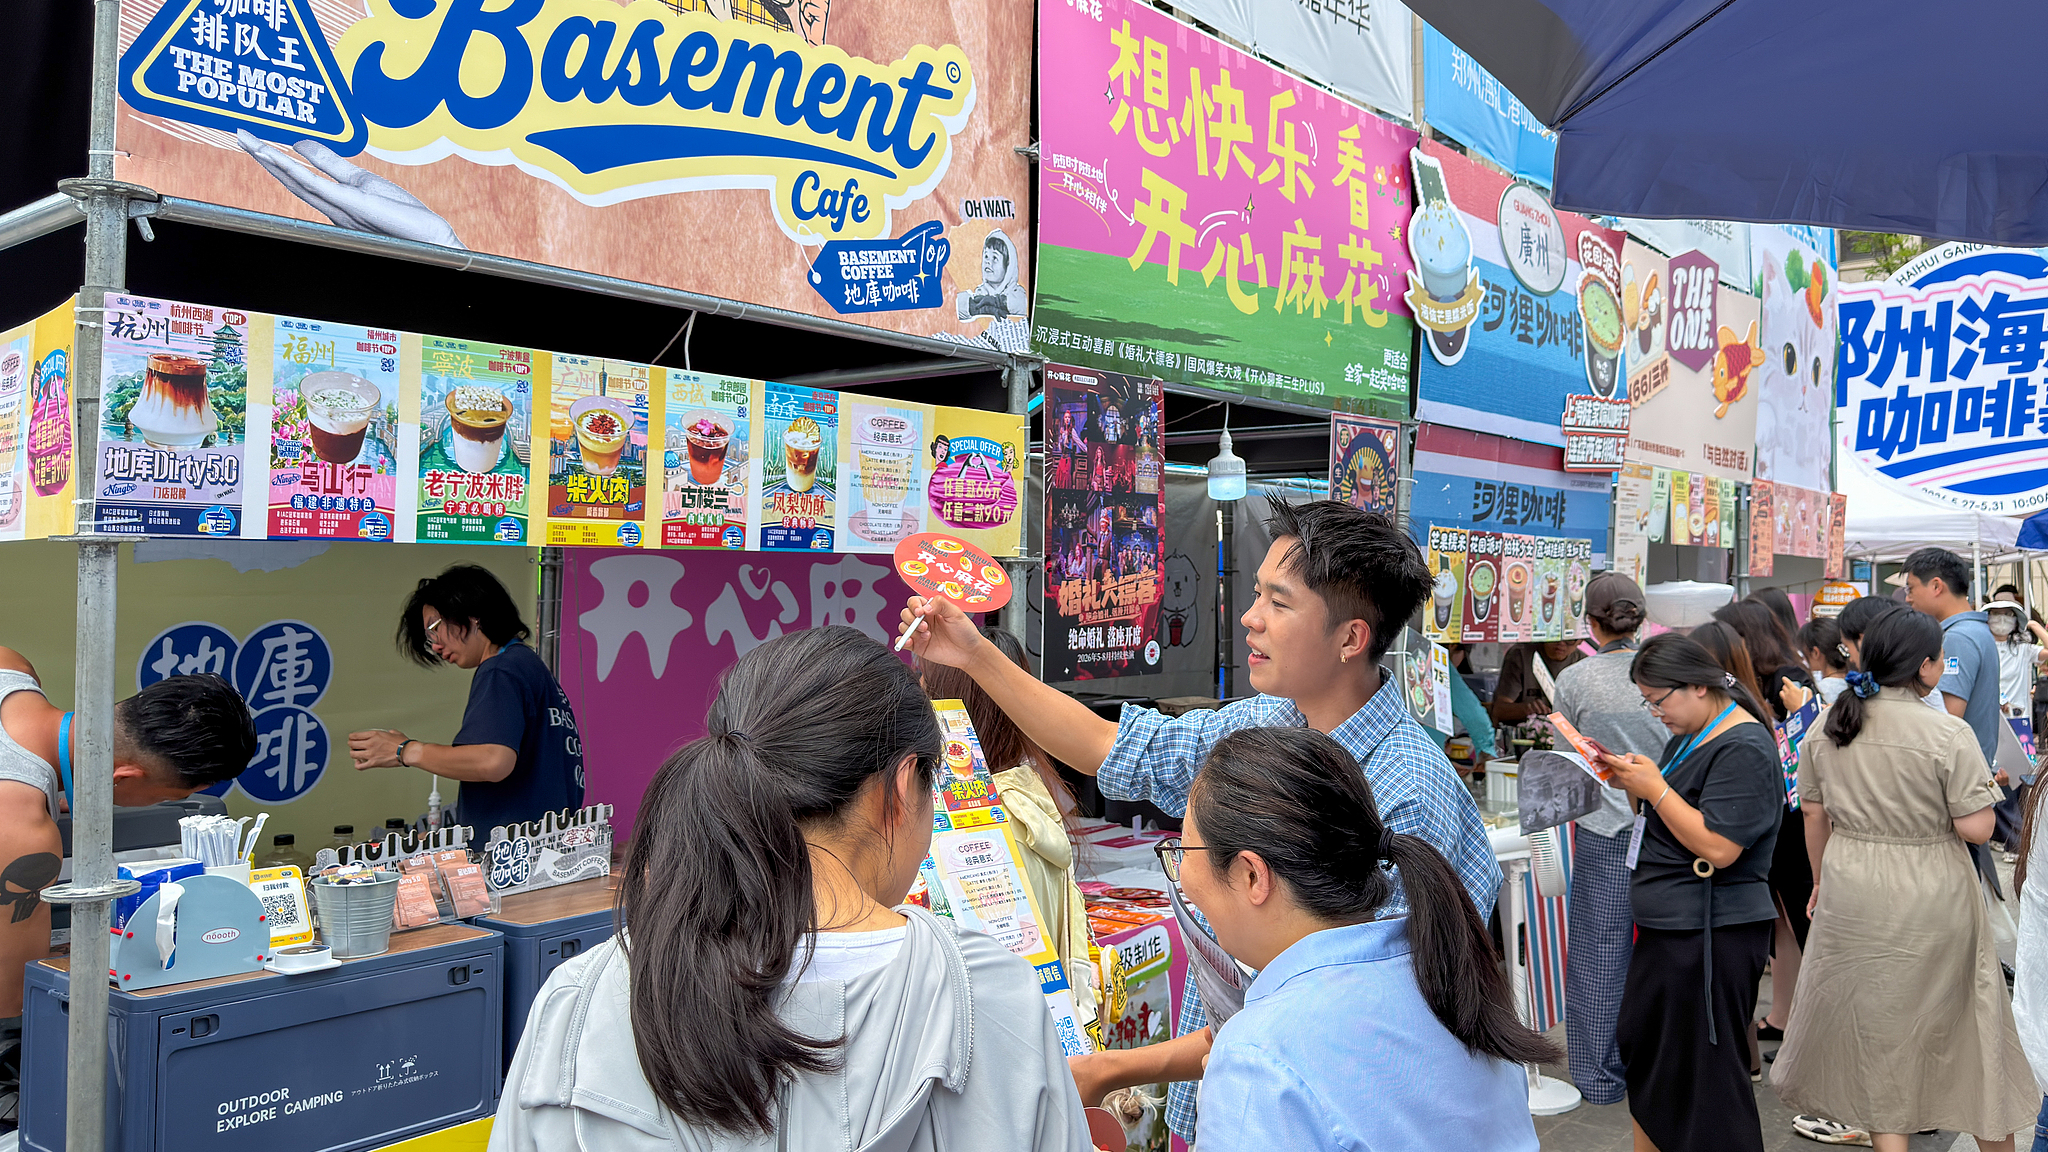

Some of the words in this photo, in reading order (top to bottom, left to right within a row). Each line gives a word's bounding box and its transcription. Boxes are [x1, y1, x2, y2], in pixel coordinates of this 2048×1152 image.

[190, 10, 306, 71] 排队王
[169, 45, 233, 82] THE
[237, 64, 325, 104] MOST
[352, 0, 953, 169] Basement
[177, 70, 317, 125] POPULAR
[1053, 153, 1103, 183] 随时随地
[791, 170, 871, 233] Cafe
[1063, 172, 1107, 213] 开心相伴
[965, 200, 983, 218] OH
[984, 200, 1015, 220] WAIT,
[838, 250, 917, 266] BASEMENT
[902, 225, 947, 278] Top
[1128, 166, 1388, 328] 开心麻花
[1518, 222, 1550, 276] 廣州
[840, 264, 894, 280] COFFEE
[1896, 254, 1940, 286] HAIHUI
[844, 278, 920, 307] 地庫咖啡
[1672, 264, 1717, 312] THE
[170, 303, 214, 322] 杭州西湖
[225, 313, 243, 325] TOP1
[1482, 278, 1583, 361] 河狸咖啡
[108, 312, 170, 345] 杭州
[171, 320, 204, 336] 咖啡节
[1670, 307, 1714, 351] ONE.
[282, 333, 335, 368] 福州
[432, 351, 475, 380] 寧波
[1383, 348, 1409, 371] 更适合
[1343, 362, 1409, 393] 全家一起笑哈哈
[871, 417, 906, 430] COFFEE
[950, 439, 979, 453] SPECIAL
[979, 440, 1001, 458] OFFER
[153, 486, 187, 500] 门店招牌
[424, 470, 524, 501] 老宁波米胖
[680, 485, 729, 510] 古楼兰
[292, 494, 374, 512] 福建非遗特色
[772, 491, 826, 517] 凤梨奶酥
[1473, 480, 1567, 531] 河狸咖啡
[917, 550, 995, 595] 开心麻花
[1067, 626, 1105, 650] 绝命婚礼
[1106, 624, 1142, 648] 落座开席
[496, 838, 529, 860] 地庫
[958, 841, 992, 854] COFFEE
[493, 860, 529, 884] 咖啡
[216, 1106, 278, 1133] EXPLORE
[284, 1090, 344, 1115] CAMPING
[217, 1087, 290, 1116] OUTDOOR
